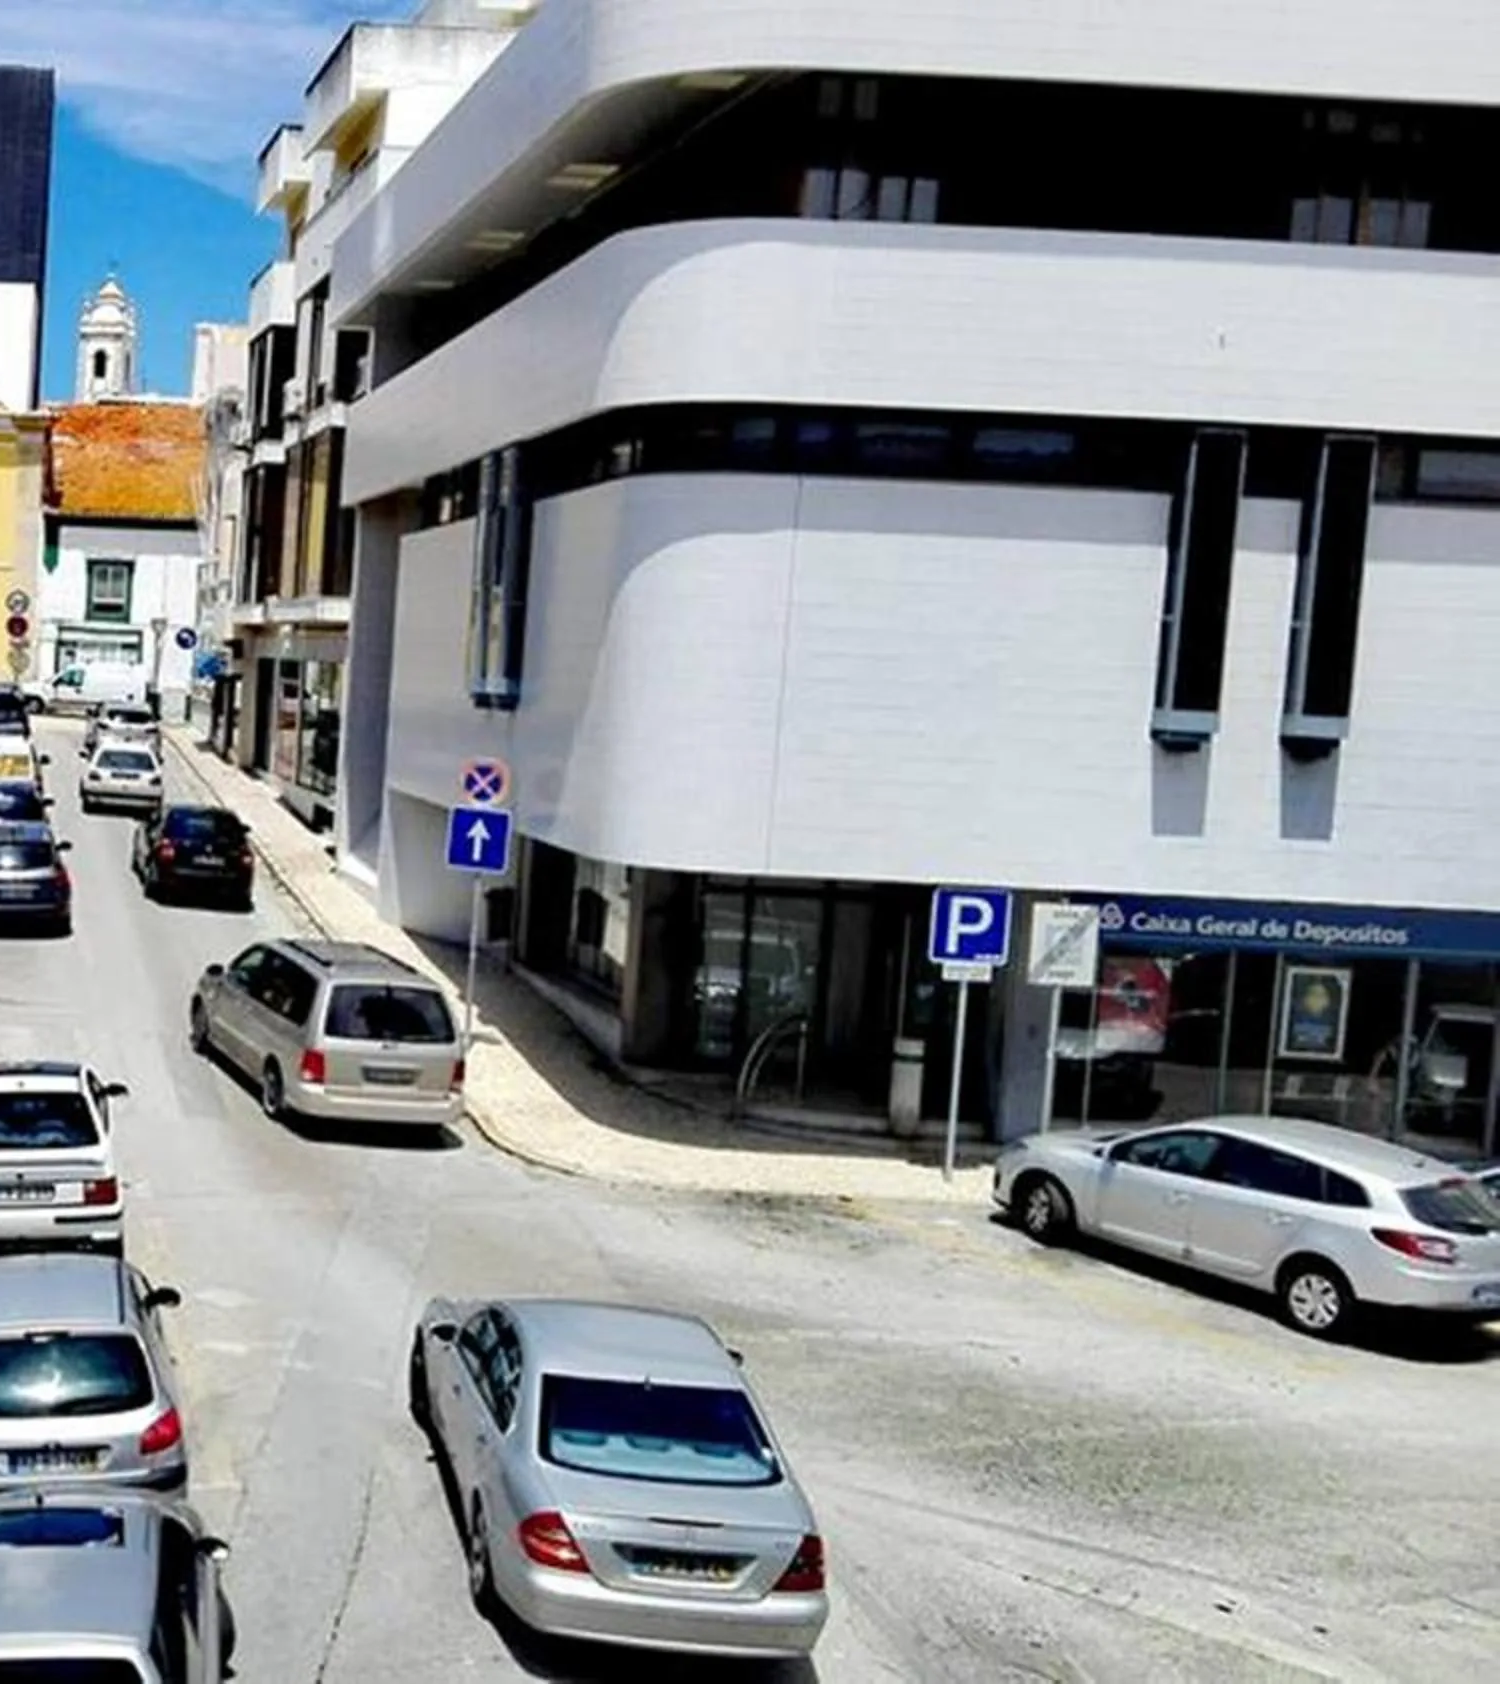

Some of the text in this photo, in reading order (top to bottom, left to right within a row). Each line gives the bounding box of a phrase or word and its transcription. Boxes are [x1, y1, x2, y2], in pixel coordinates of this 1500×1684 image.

[945, 896, 994, 954] P
[1130, 911, 1192, 933] Caixa
[1196, 914, 1258, 938] Geral
[1261, 919, 1289, 939] de
